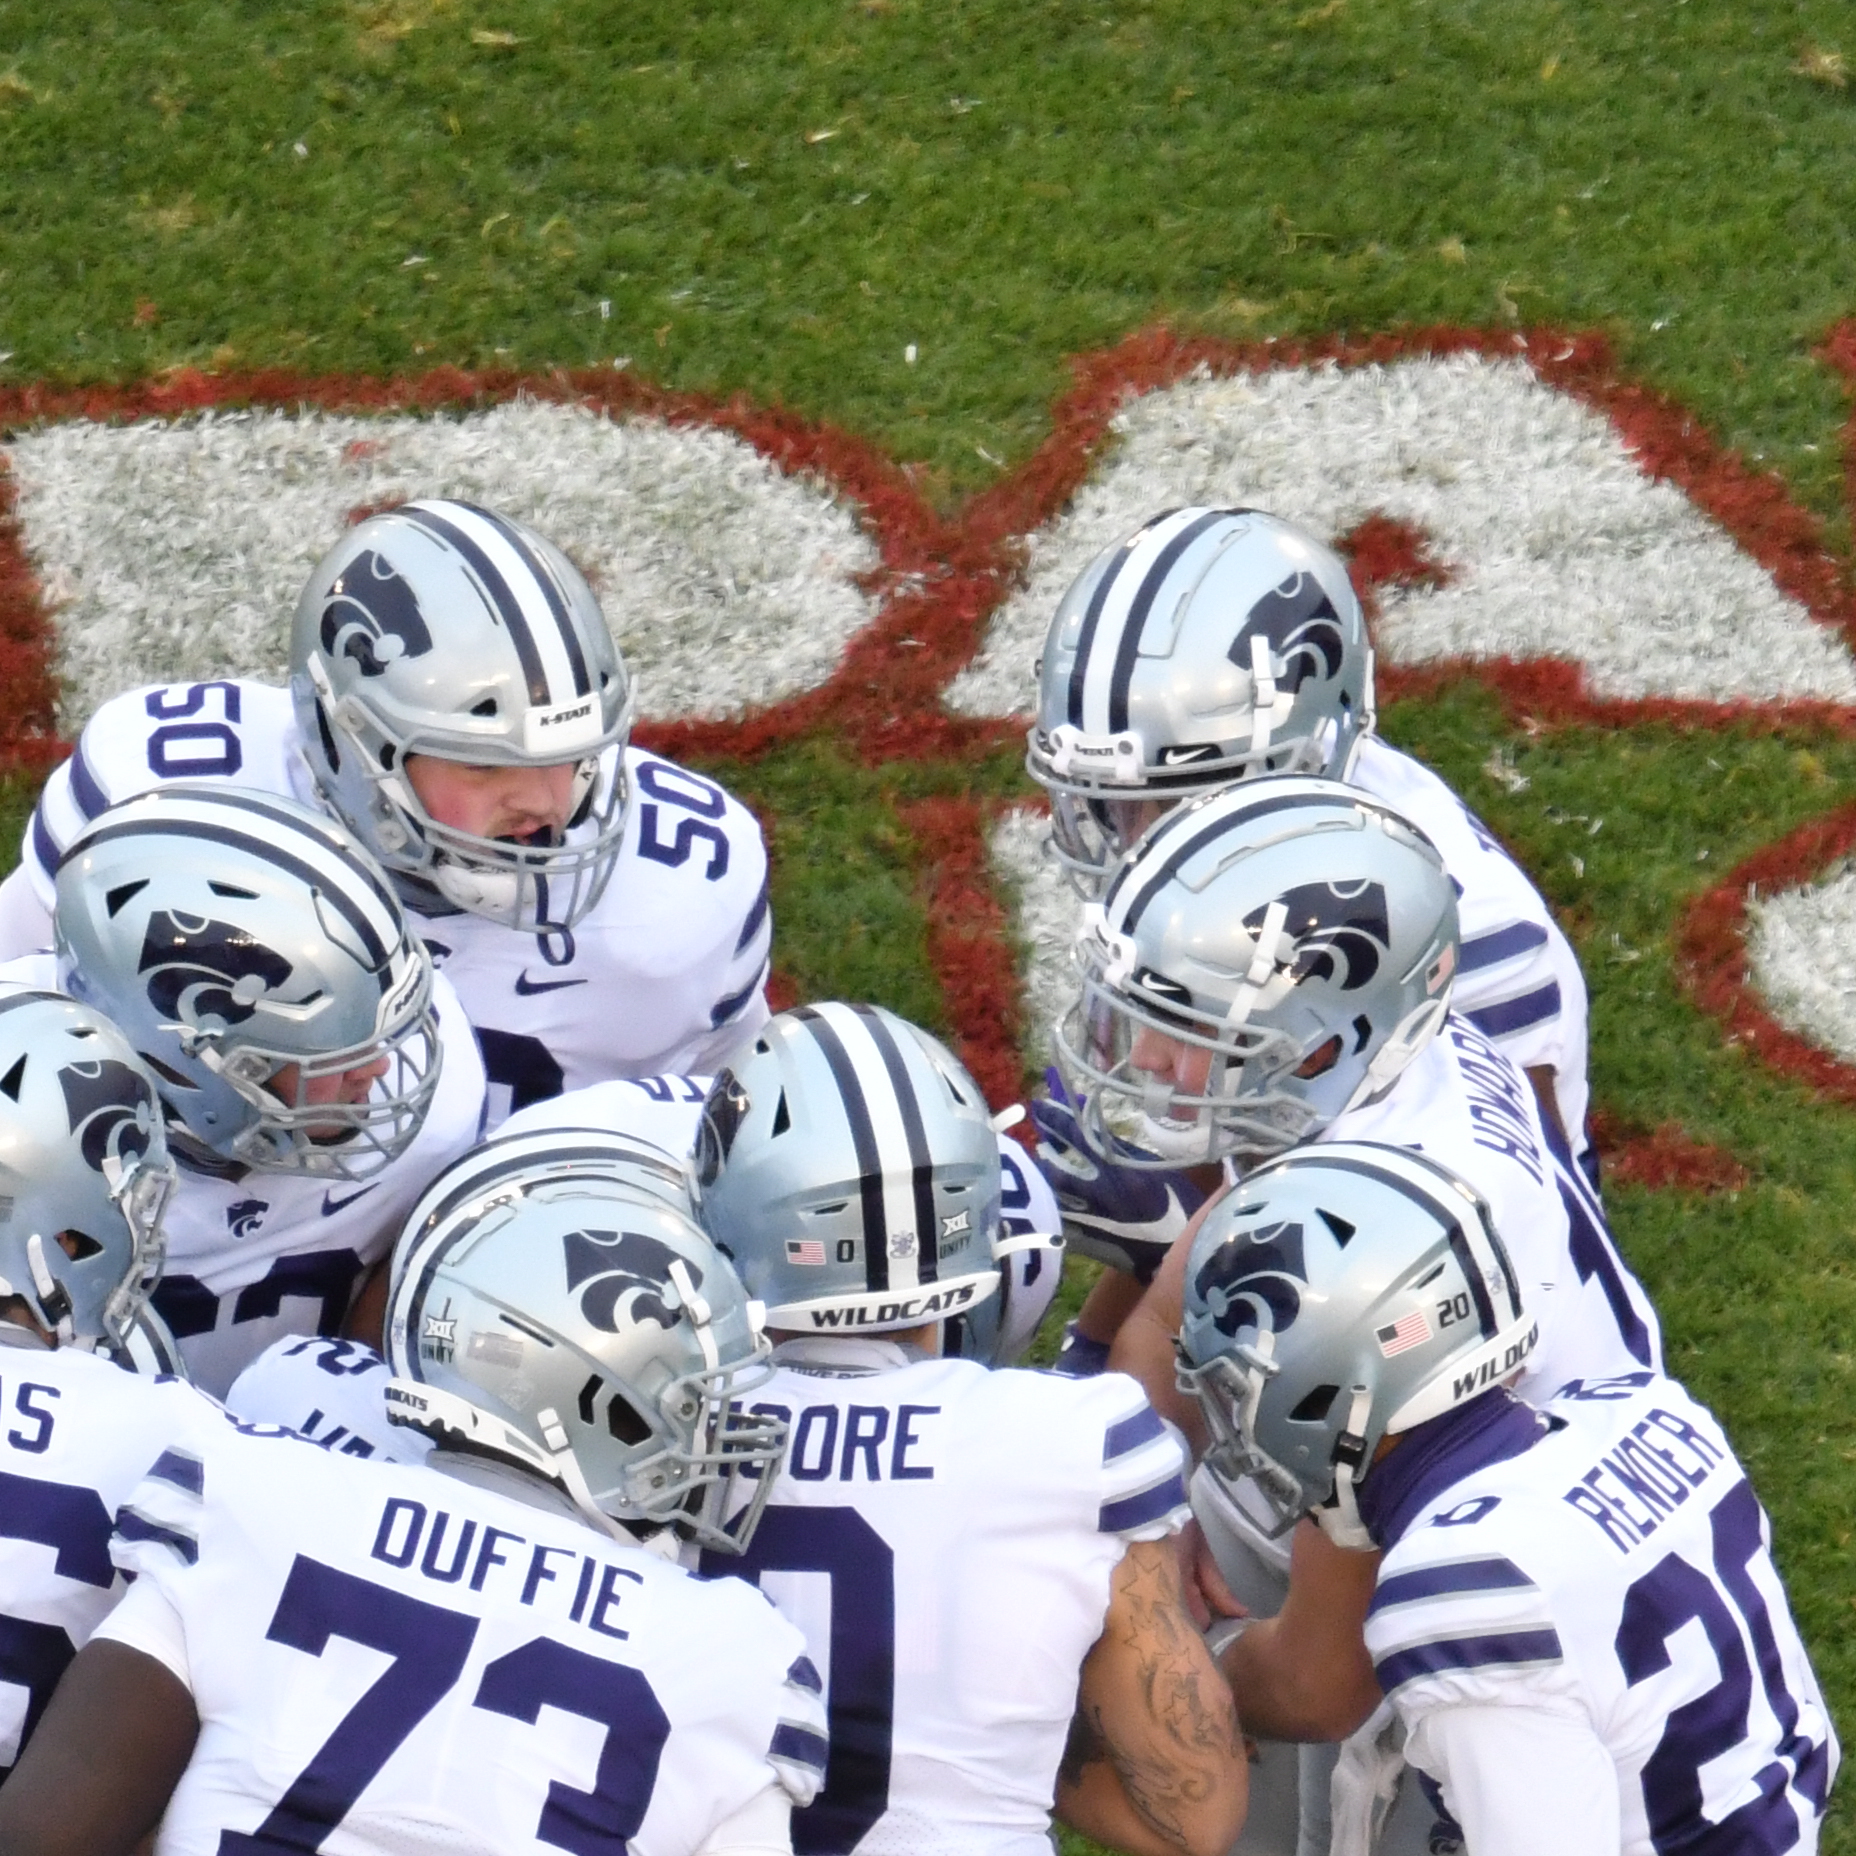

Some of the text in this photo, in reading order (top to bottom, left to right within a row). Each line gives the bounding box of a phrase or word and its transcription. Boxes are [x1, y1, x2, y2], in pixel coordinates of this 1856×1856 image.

[145, 681, 242, 779] 50
[635, 760, 729, 883] 50
[836, 1239, 854, 1263] 0
[811, 1283, 976, 1328] WILDCATS
[1436, 1292, 1470, 1329] 20
[1561, 1408, 1726, 1555] RENDER
[370, 1497, 644, 1641] DUFFIE
